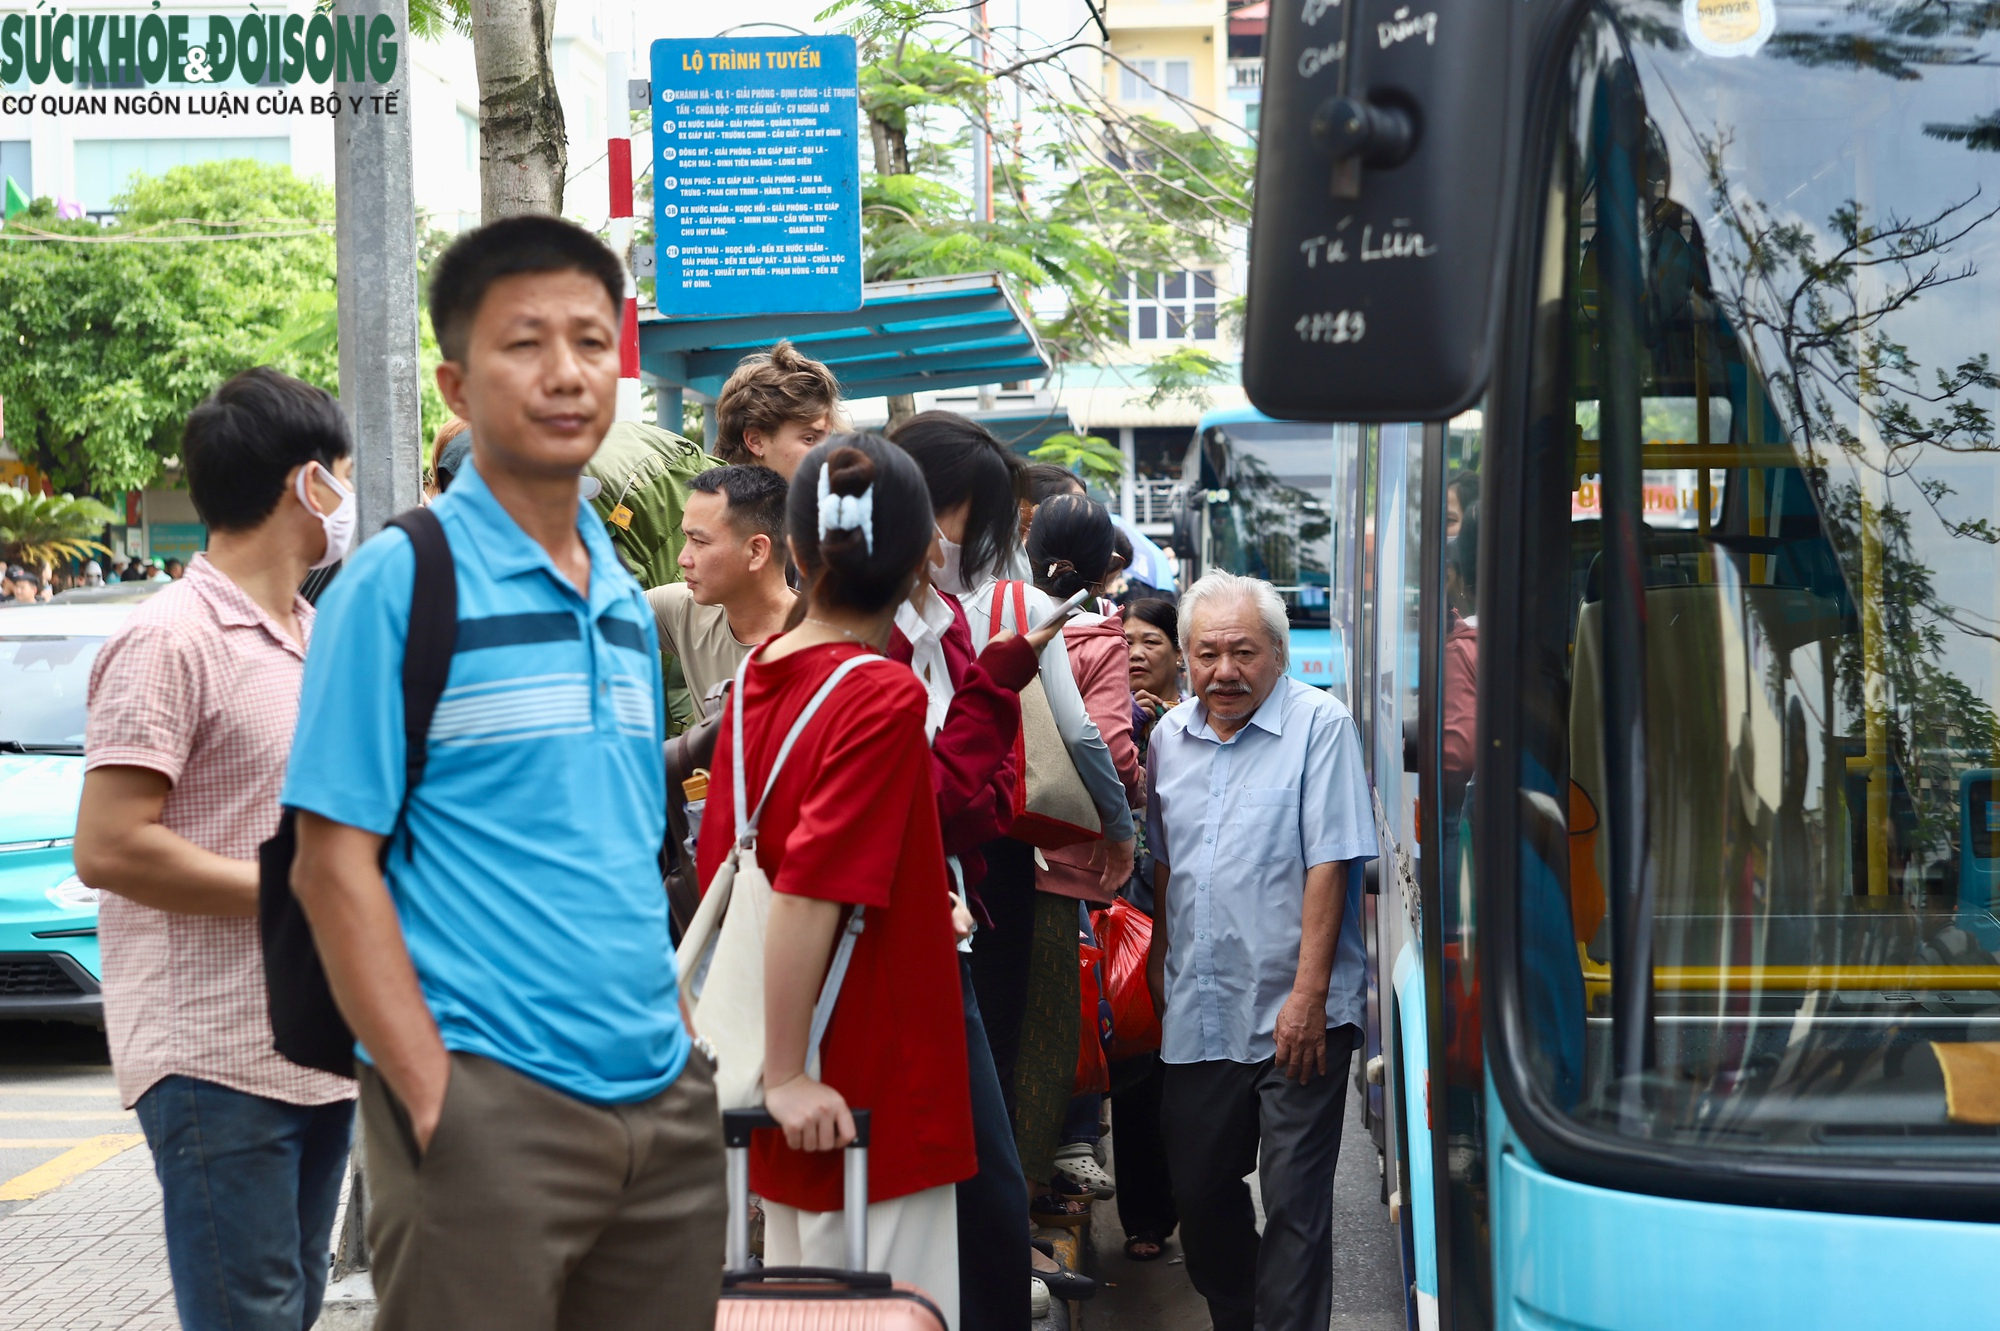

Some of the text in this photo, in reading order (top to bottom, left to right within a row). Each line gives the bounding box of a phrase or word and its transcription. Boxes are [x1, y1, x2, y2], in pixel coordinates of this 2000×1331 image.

[683, 45, 820, 74] LỘ TRÌNH TUYẾN
[715, 90, 724, 98] QL
[787, 105, 796, 113] CV
[788, 226, 808, 234] GIANG
